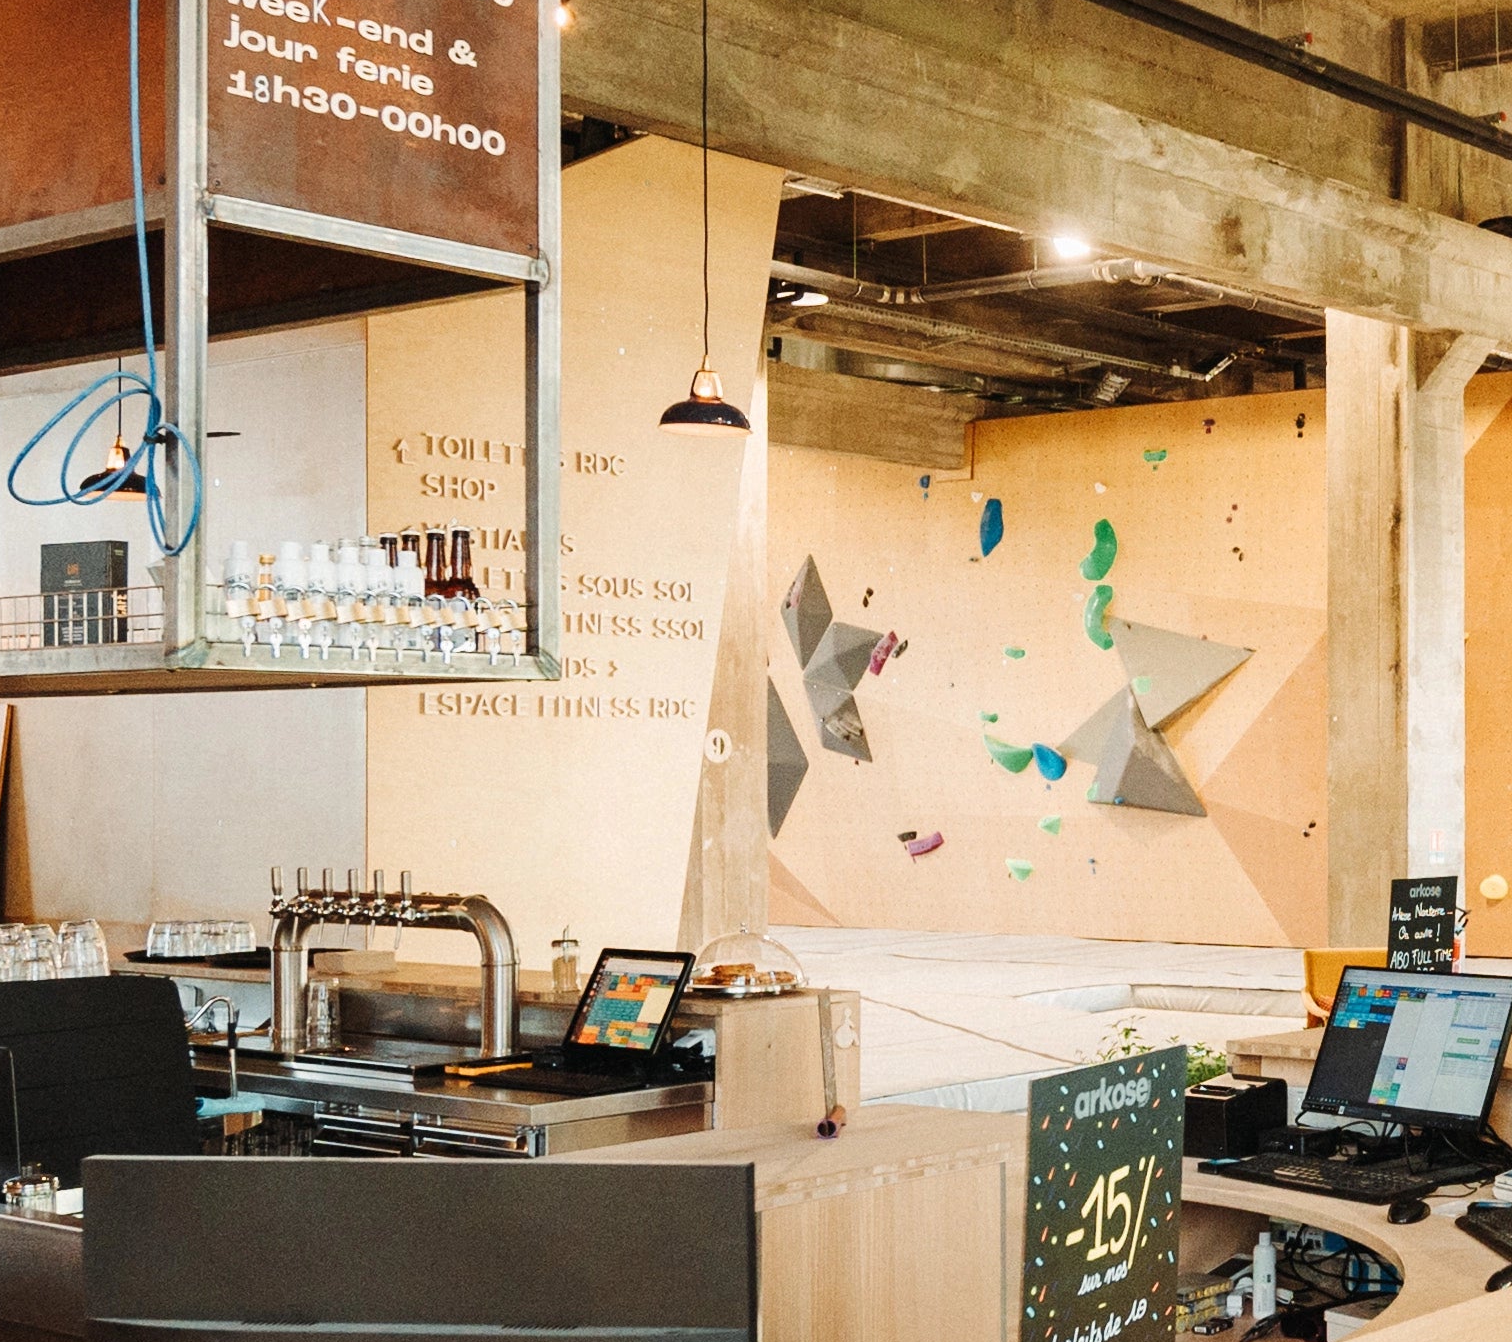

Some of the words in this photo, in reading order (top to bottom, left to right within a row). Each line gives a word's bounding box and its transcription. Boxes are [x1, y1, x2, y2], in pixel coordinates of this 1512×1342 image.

[223, 14, 318, 64] jour
[336, 45, 435, 97] ferie
[447, 39, 478, 68] &
[226, 68, 507, 157] 18h30-00h00
[575, 450, 627, 477] RDC
[420, 472, 500, 503] SHOP
[577, 572, 653, 600] SOUS
[419, 691, 528, 718] ESPACE
[536, 693, 642, 720] FITNESS
[648, 696, 697, 720] RDC
[712, 735, 726, 756] 9
[1409, 883, 1442, 899] arkose
[1389, 950, 1410, 970] ABO
[1411, 948, 1433, 966] FULL
[1073, 1075, 1152, 1121] arkose
[1077, 1272, 1103, 1297] sur
[1103, 1260, 1129, 1286] nos
[1103, 1311, 1122, 1342] de
